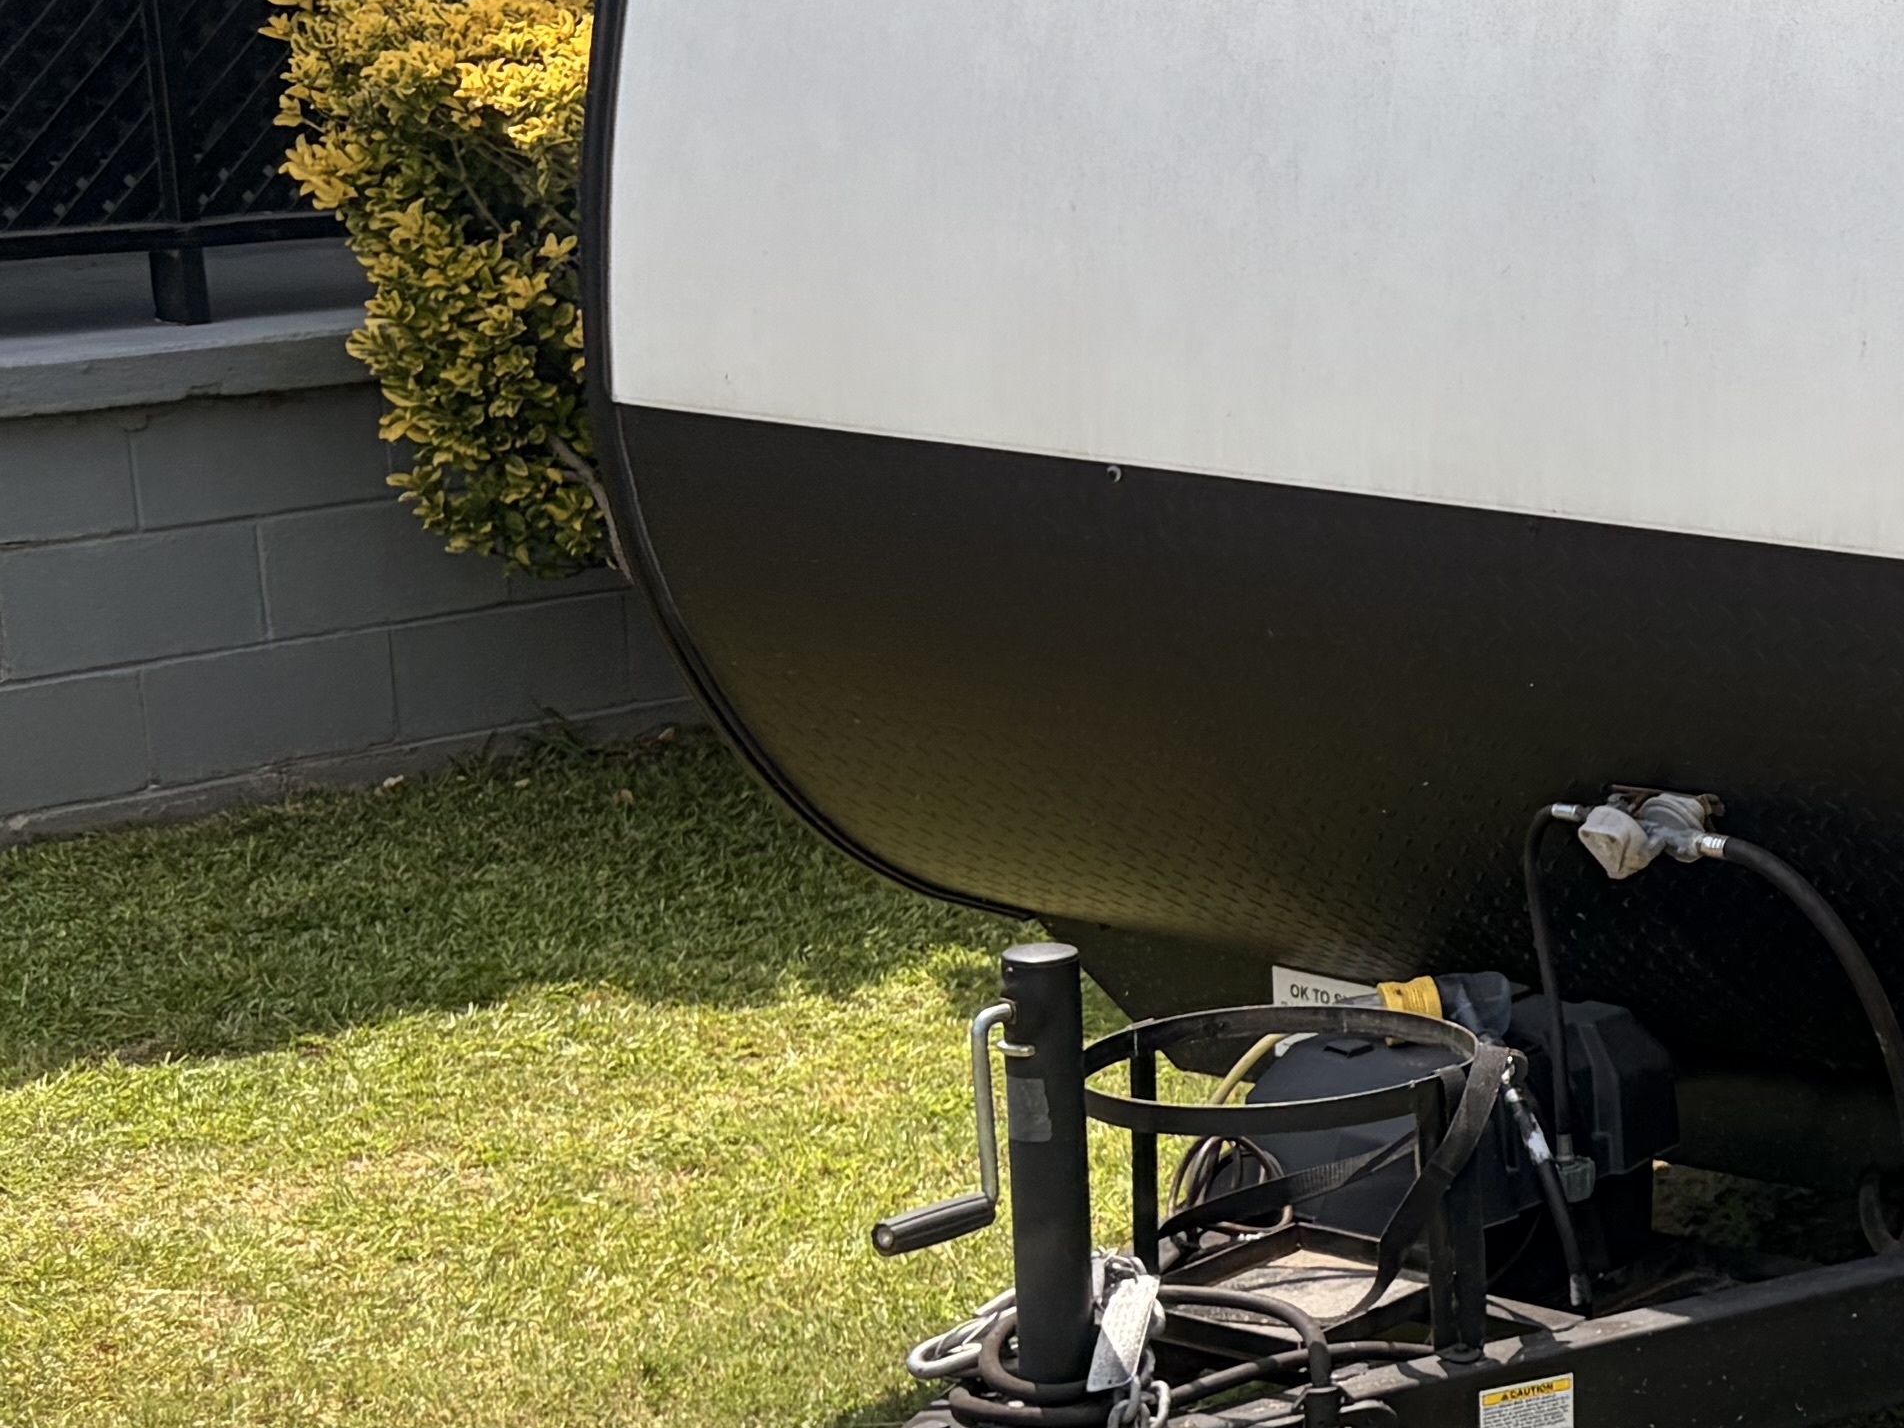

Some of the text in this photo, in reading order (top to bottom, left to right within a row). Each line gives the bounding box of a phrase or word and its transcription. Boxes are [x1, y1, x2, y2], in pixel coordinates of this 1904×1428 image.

[1290, 983, 1309, 1001] OK
[1312, 988, 1330, 1004] TO
[1510, 1382, 1554, 1399] CAUTION
